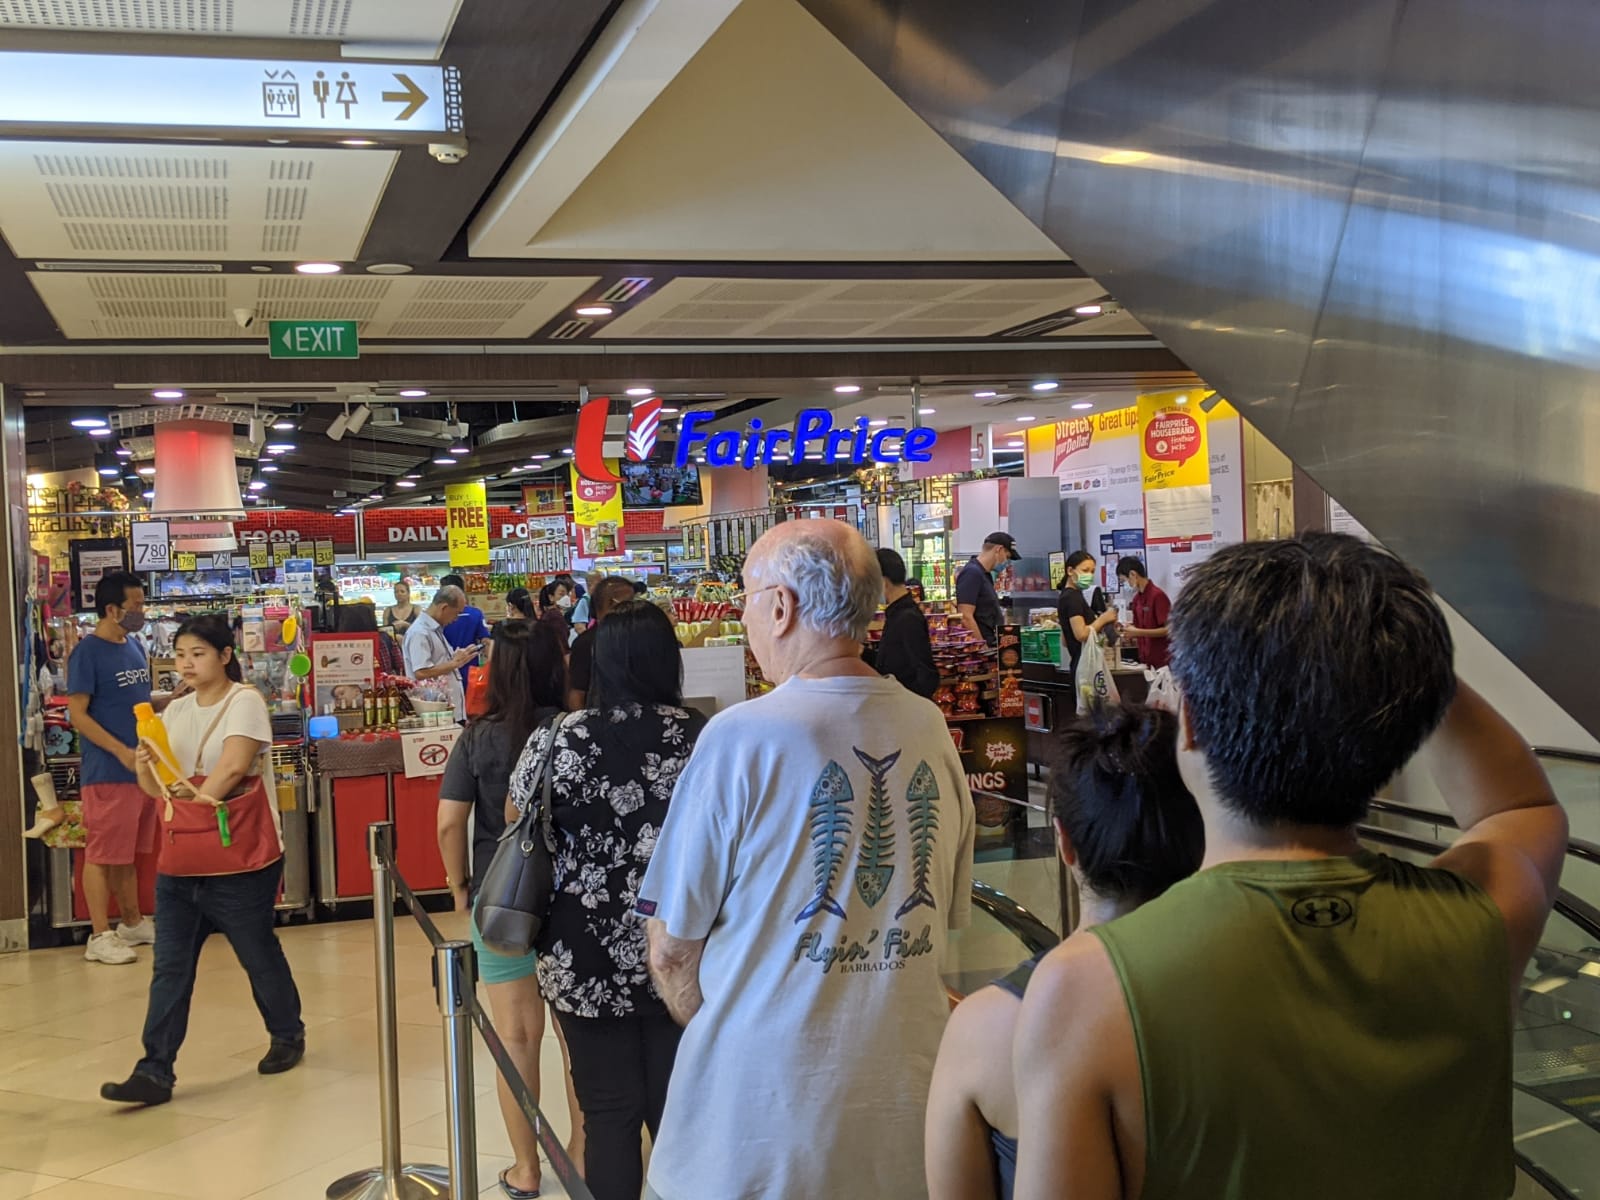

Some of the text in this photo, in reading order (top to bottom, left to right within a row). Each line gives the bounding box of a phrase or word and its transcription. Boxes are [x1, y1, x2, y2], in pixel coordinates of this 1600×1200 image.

[295, 326, 345, 352] EXIT
[1099, 411, 1122, 431] Great
[1155, 418, 1189, 430] FAIRPRICE
[676, 409, 937, 469] FairPrice
[1151, 426, 1195, 438] HOUSEBRAND
[976, 432, 985, 460] 5
[1144, 470, 1175, 483] FairPrice
[449, 506, 485, 528] FREE
[240, 530, 300, 546] FOOD
[388, 526, 448, 543] DAILY
[136, 543, 167, 564] 7.80
[794, 924, 933, 974] Flyin' Fish
[840, 959, 906, 974] BARBADOS
